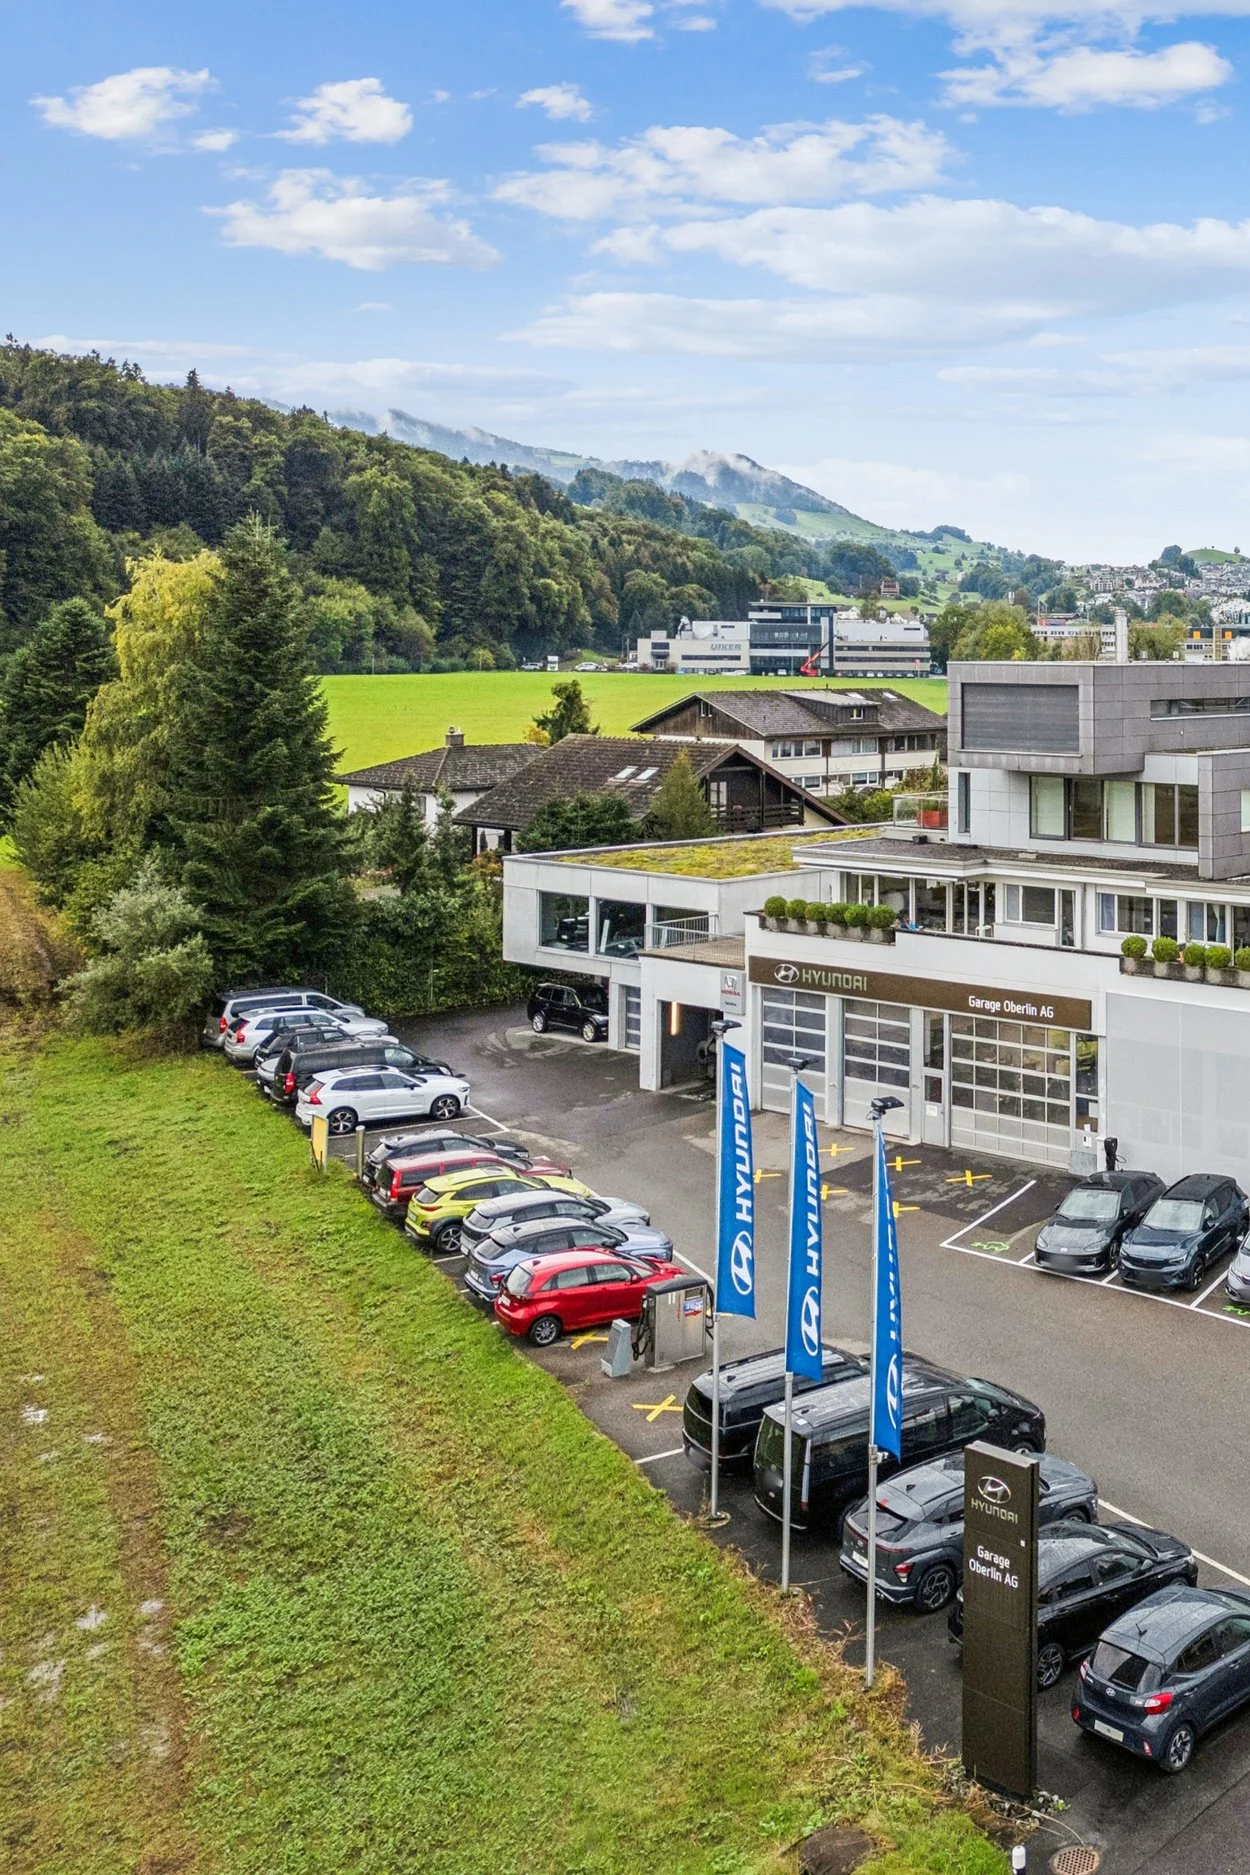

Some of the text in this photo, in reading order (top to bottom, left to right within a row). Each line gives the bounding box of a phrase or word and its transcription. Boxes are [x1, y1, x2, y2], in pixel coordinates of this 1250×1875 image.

[802, 968, 868, 992] HYUNDAI
[968, 995, 1054, 1018] Garage Oberlin AG
[730, 1061, 752, 1223] HYUNDAI
[802, 1101, 820, 1278] HYUNDAI
[971, 1498, 1019, 1525] HYUNDAI
[977, 1545, 1011, 1569] Garage
[968, 1558, 1019, 1588] Oberlin AG
